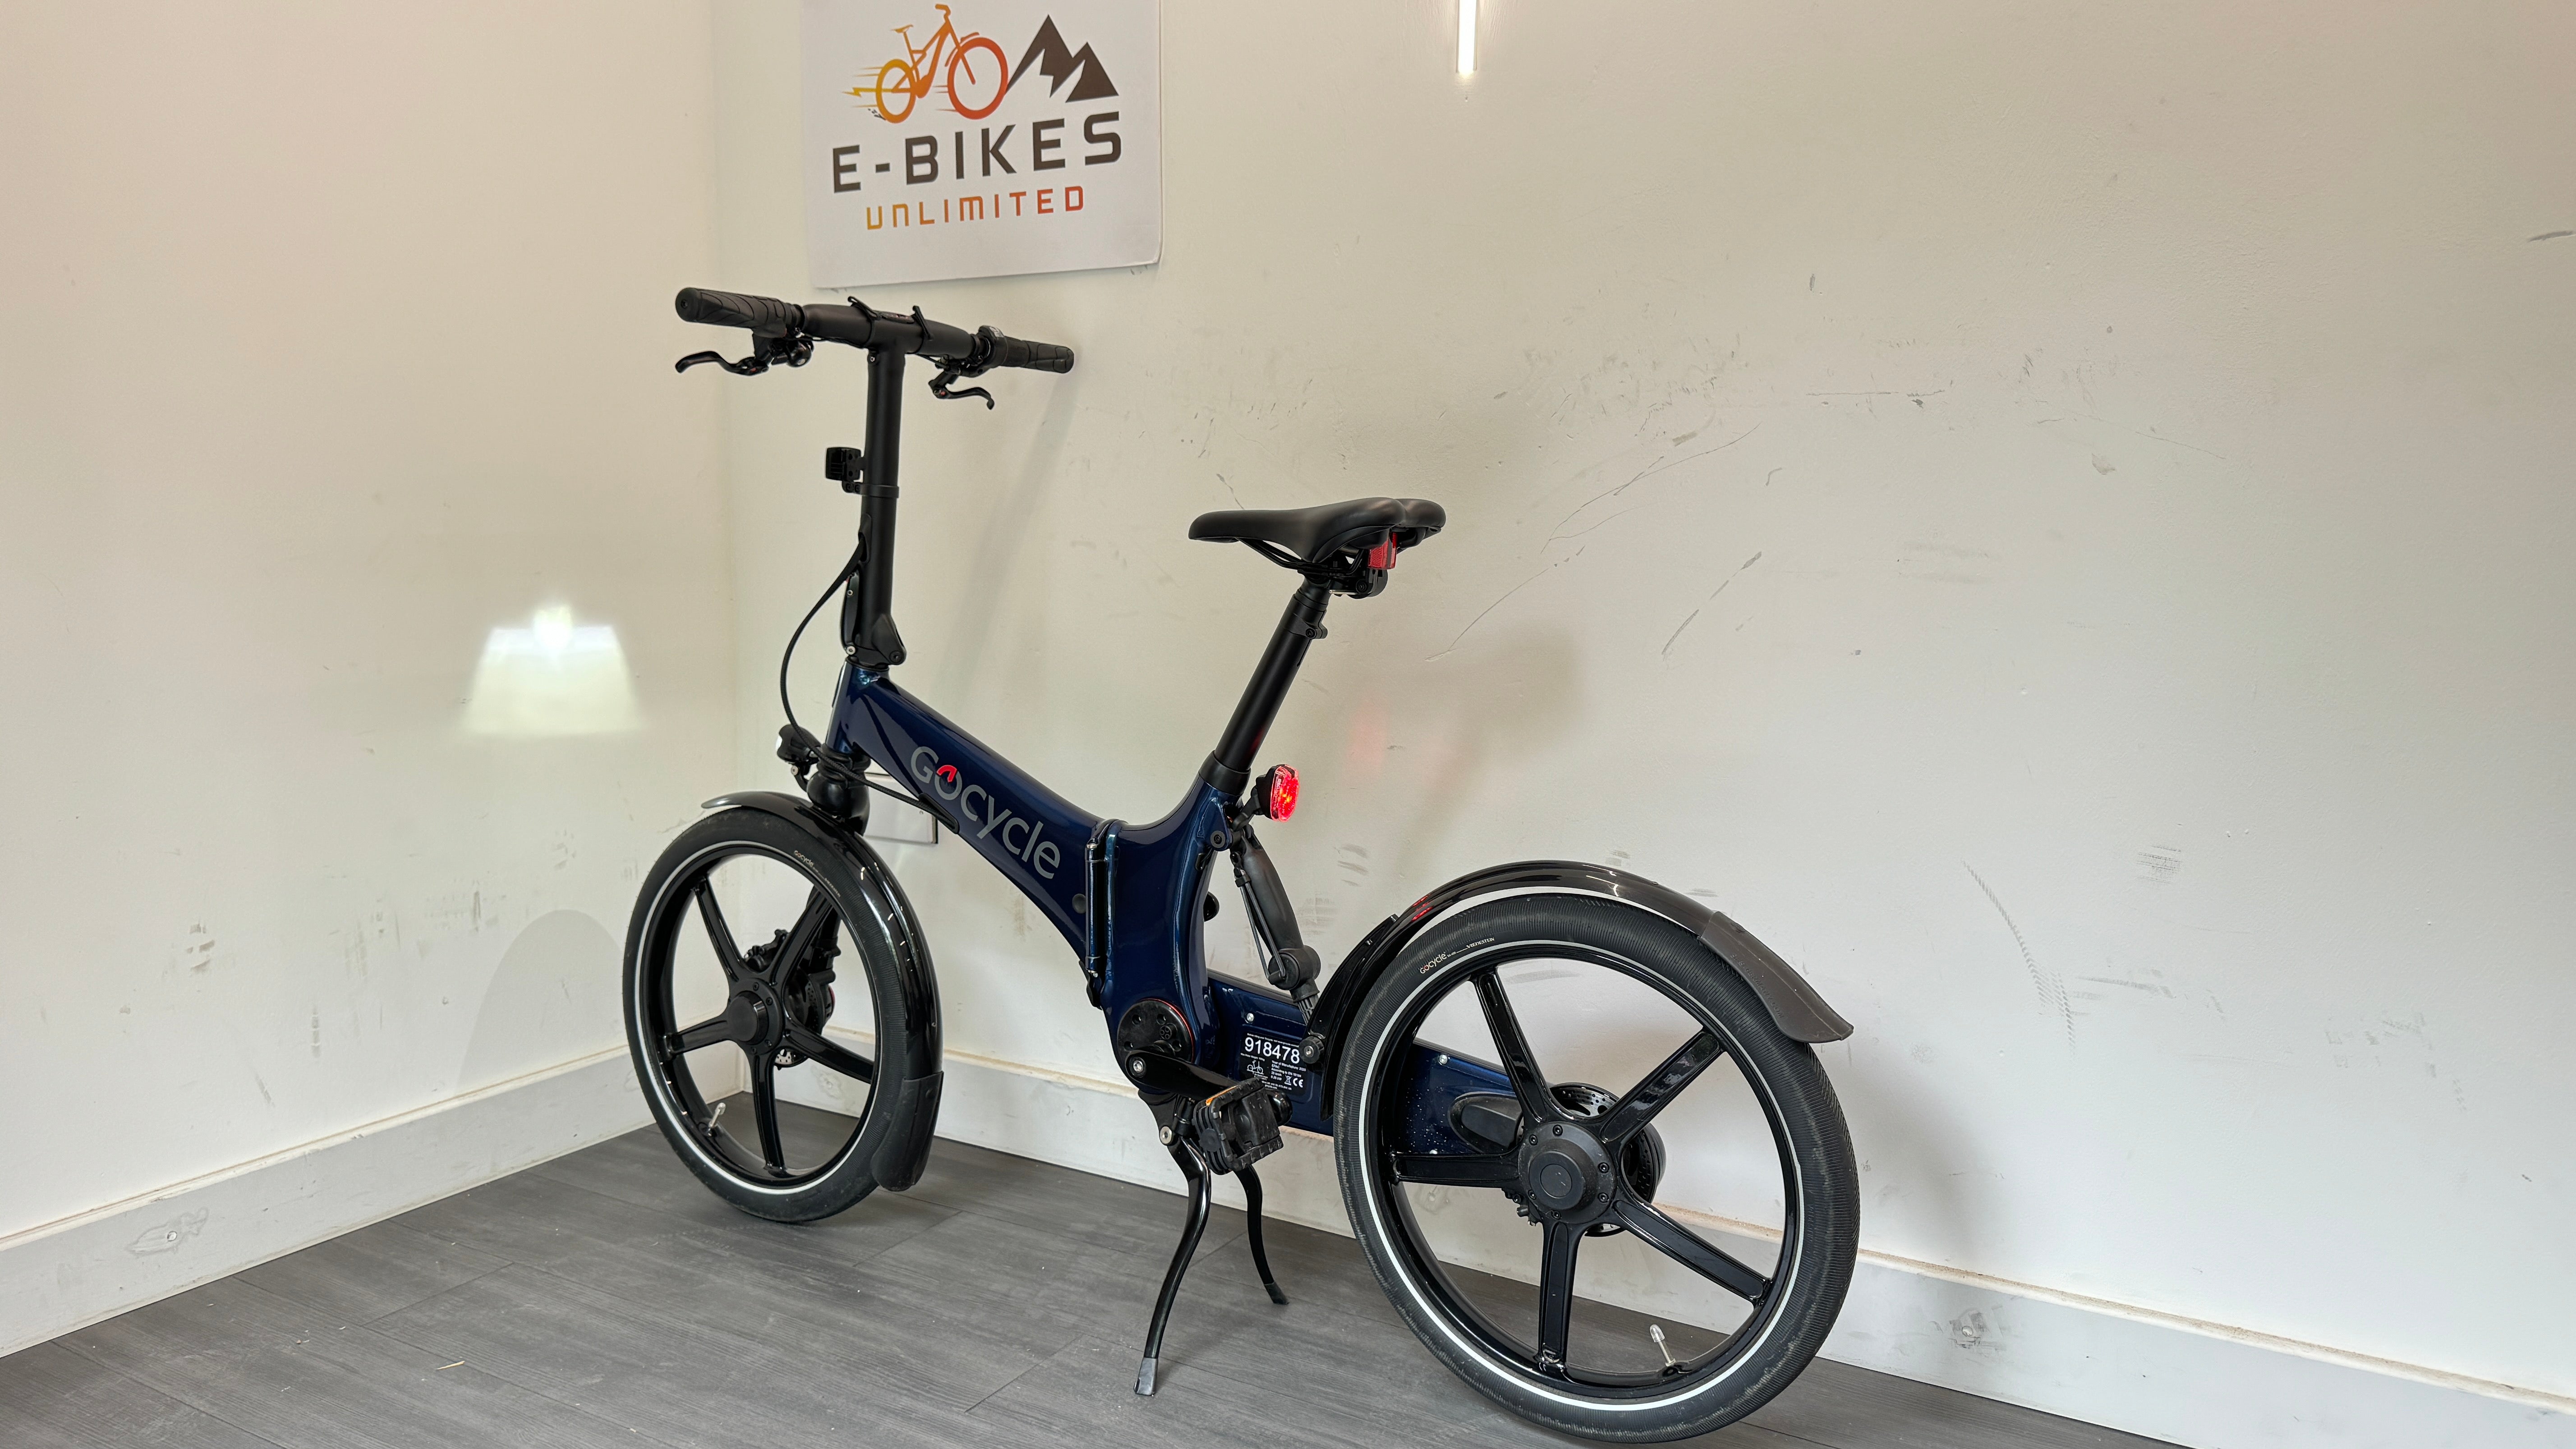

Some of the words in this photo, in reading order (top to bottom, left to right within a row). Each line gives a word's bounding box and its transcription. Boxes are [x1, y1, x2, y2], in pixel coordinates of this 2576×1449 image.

[833, 111, 1122, 193] E-BIKES
[866, 185, 1084, 230] UNLIMITED
[1245, 1037, 1300, 1064] 918478
